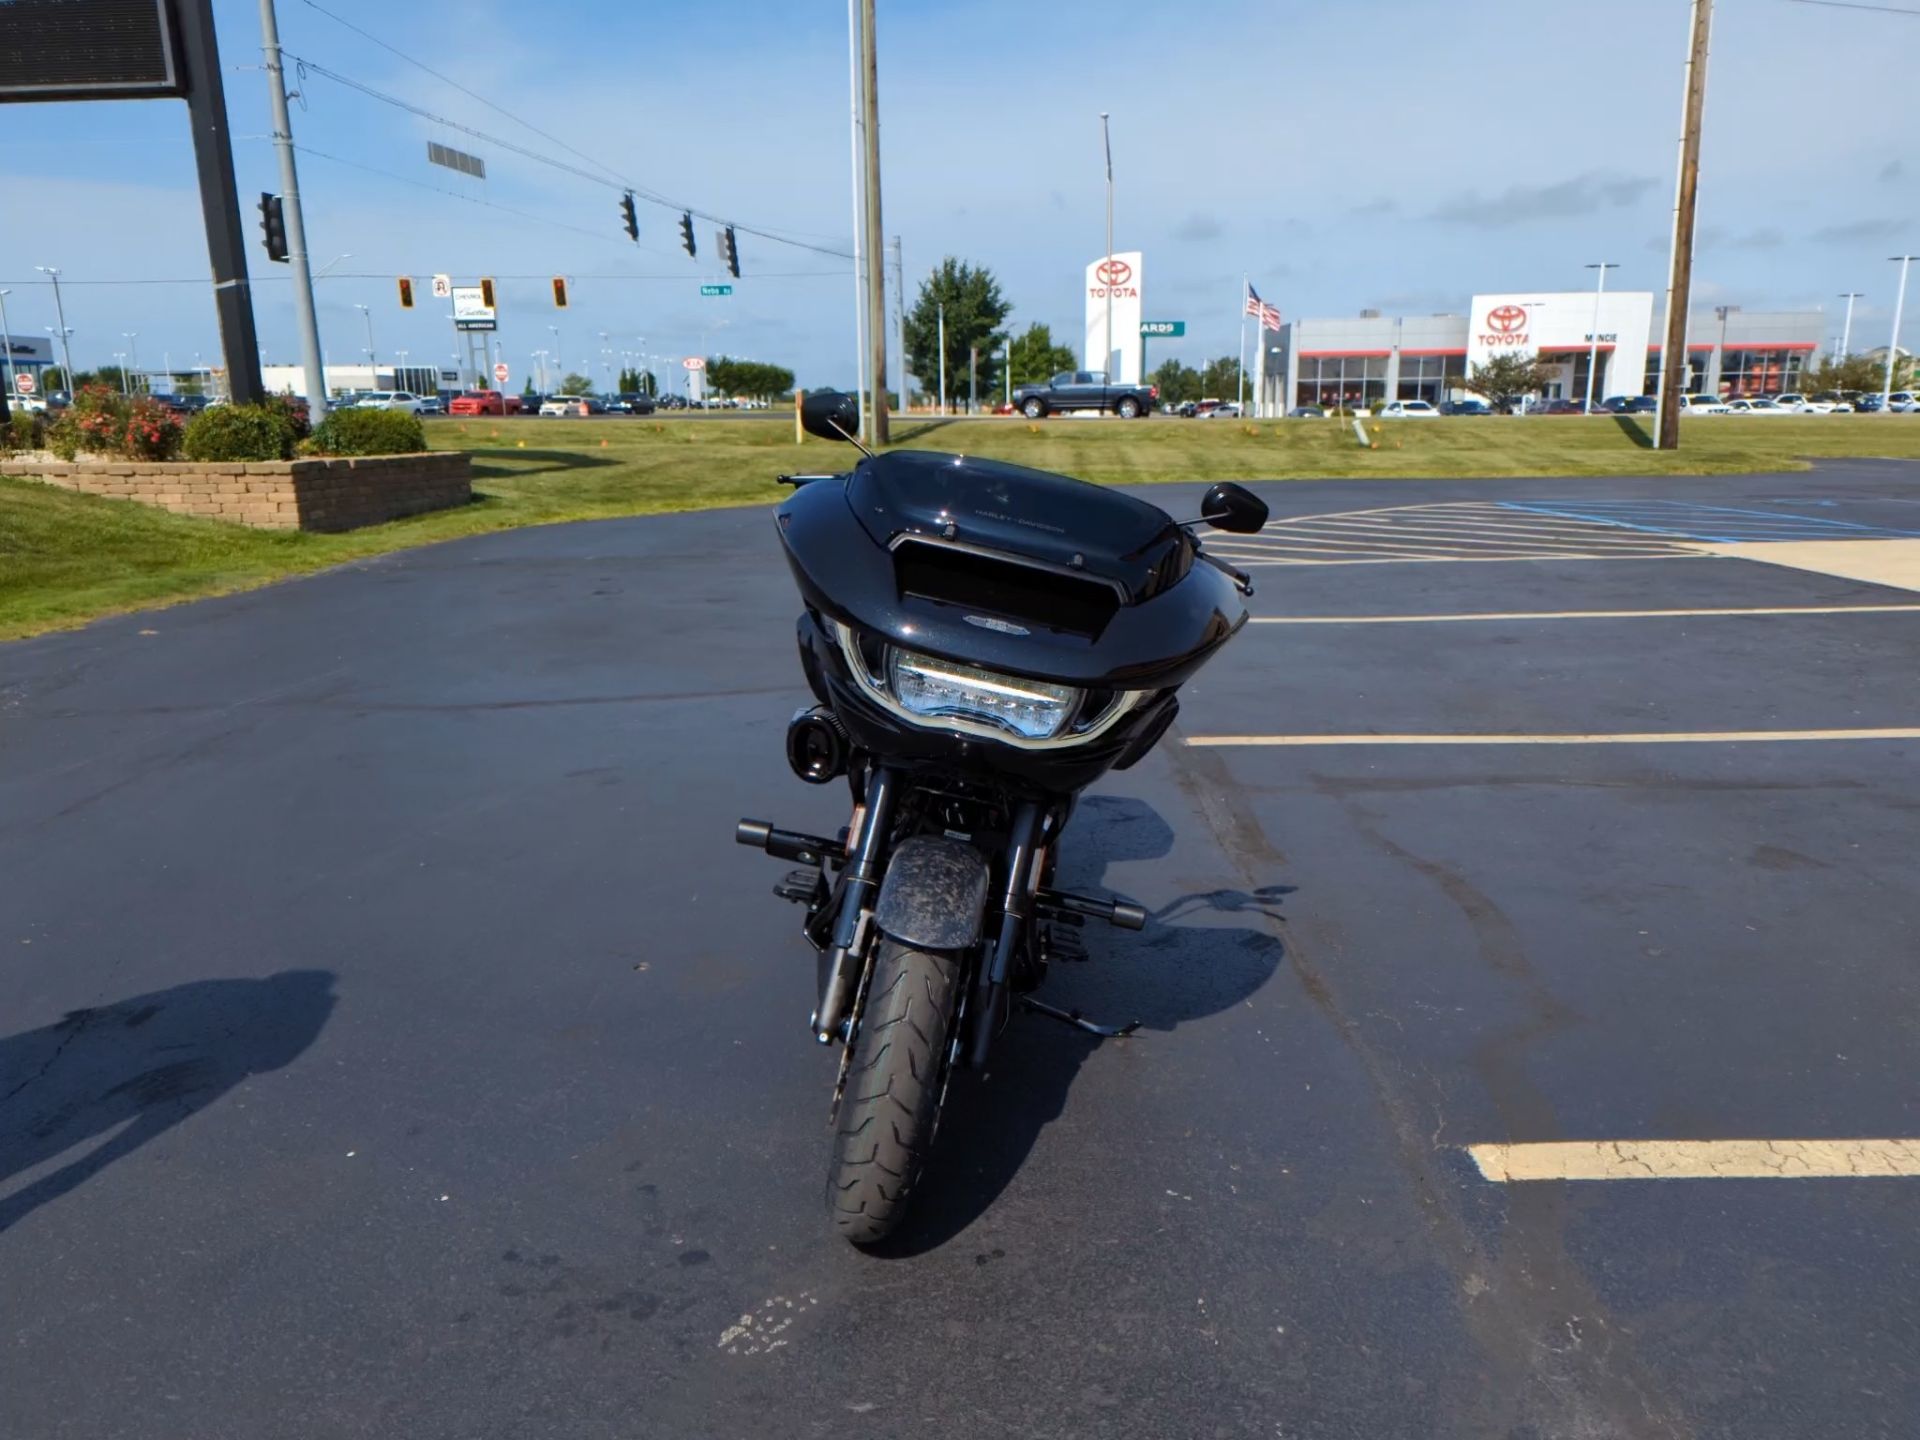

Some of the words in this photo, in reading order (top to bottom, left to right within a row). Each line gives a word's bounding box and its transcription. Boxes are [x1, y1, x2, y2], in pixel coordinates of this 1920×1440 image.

[1089, 287, 1138, 299] TOYOTA
[1140, 323, 1175, 333] ARDS
[1477, 333, 1530, 346] TOYOTA
[1584, 333, 1618, 343] MNCIE
[686, 359, 702, 368] KIA
